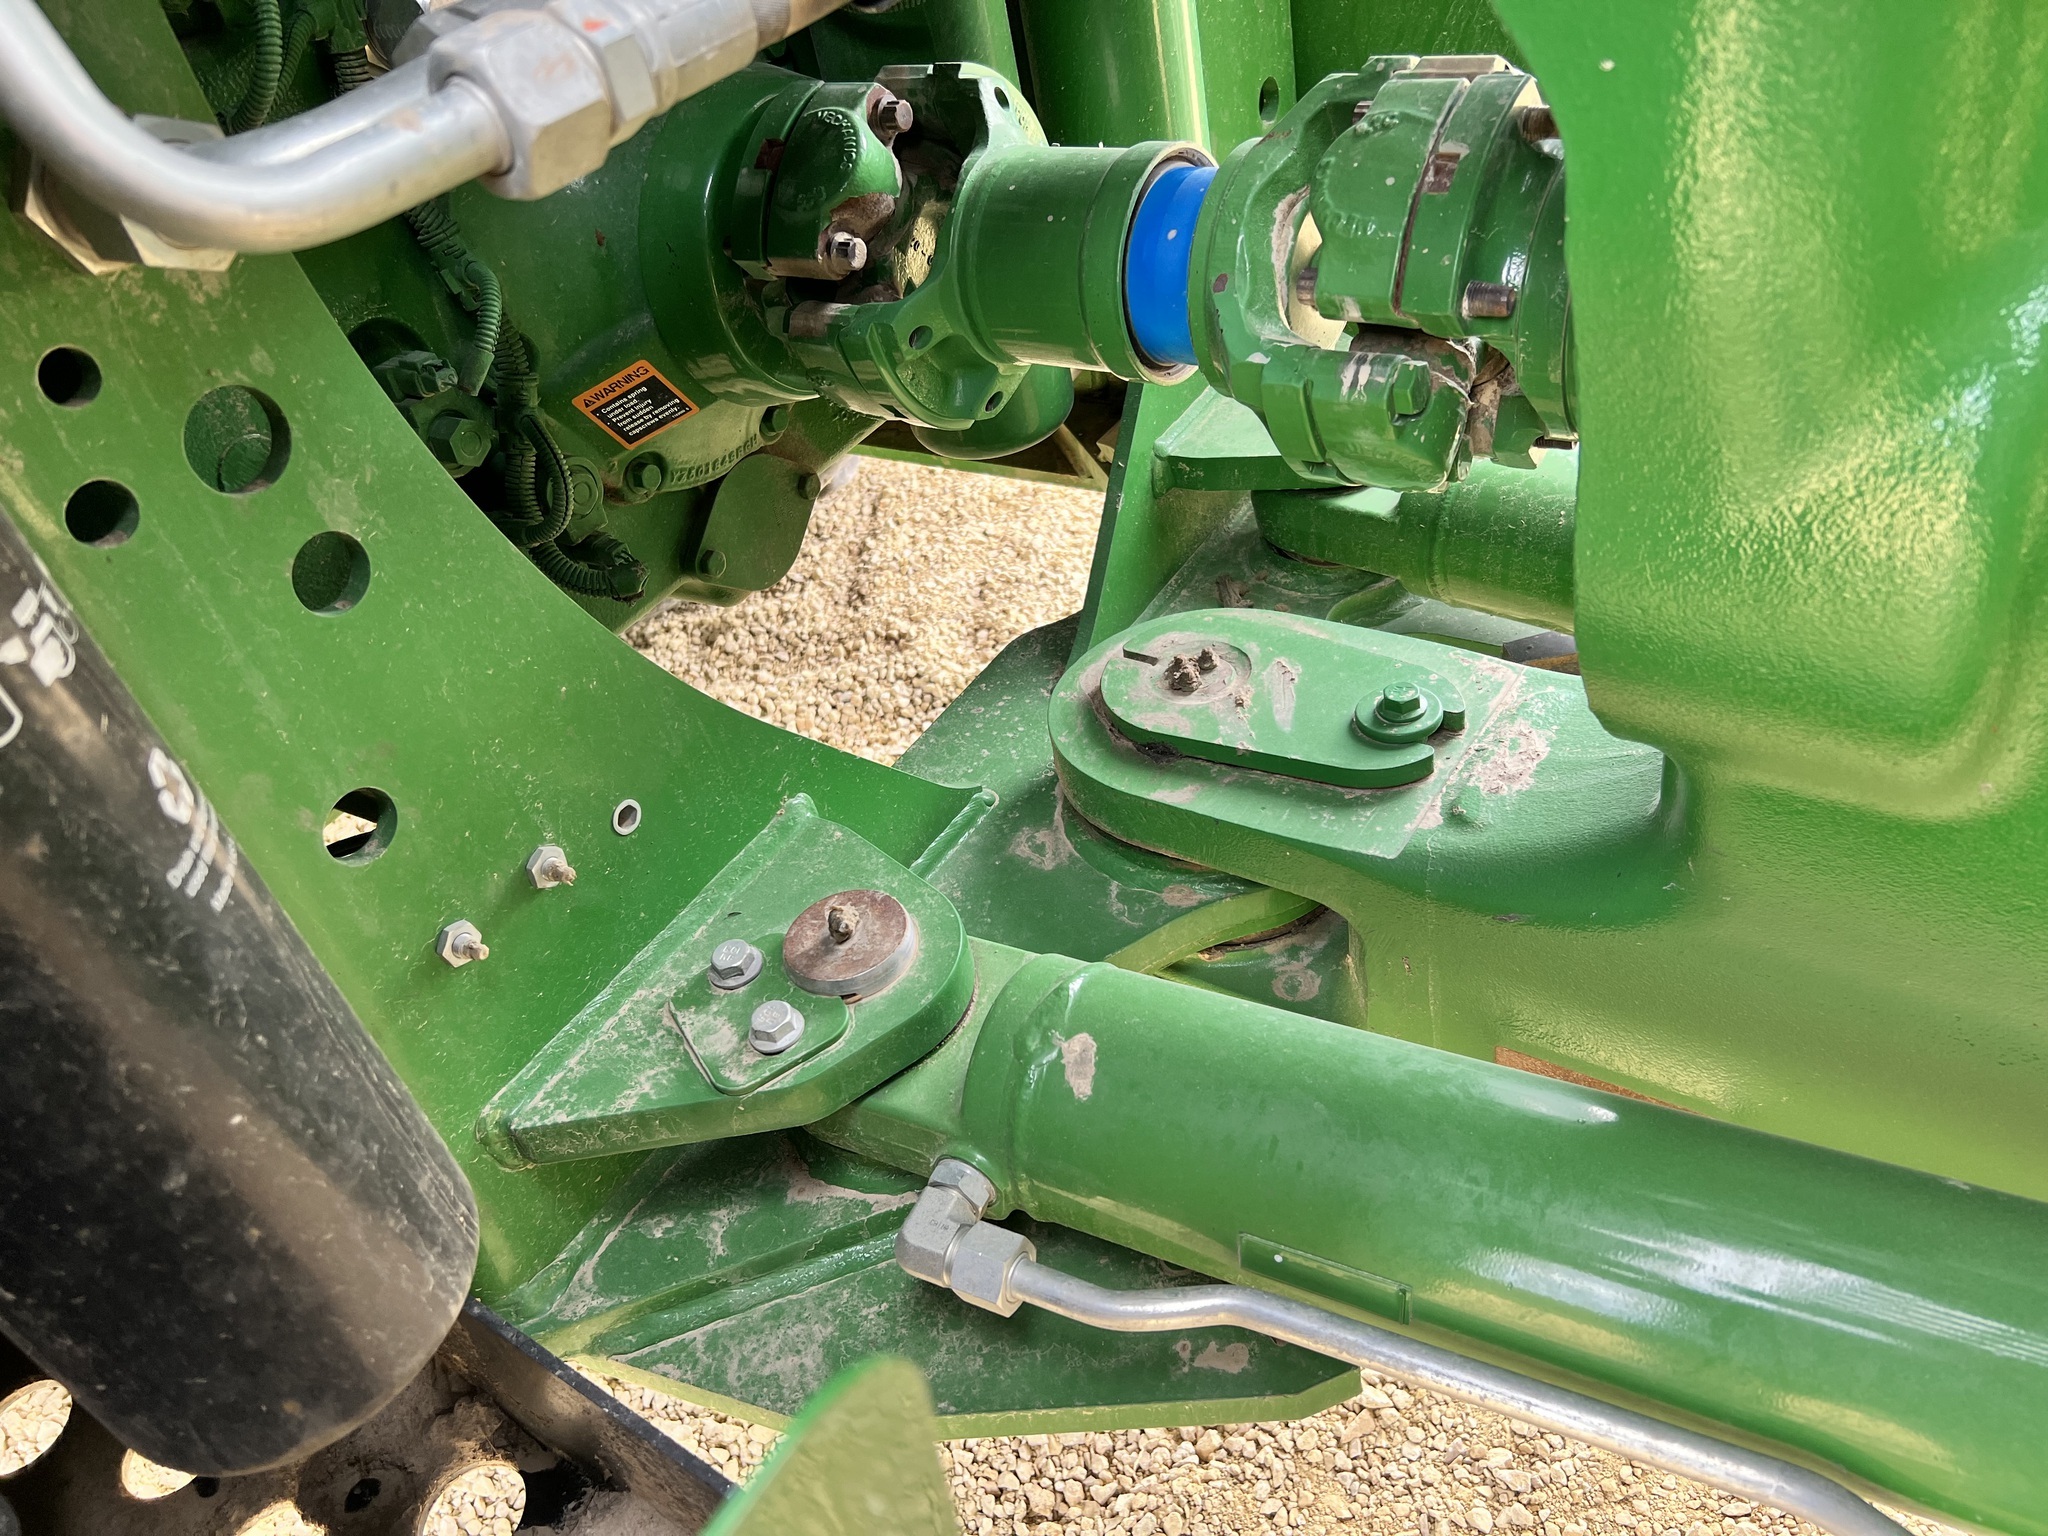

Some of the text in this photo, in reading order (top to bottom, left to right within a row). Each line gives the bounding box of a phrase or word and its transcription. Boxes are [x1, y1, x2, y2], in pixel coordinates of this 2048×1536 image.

[590, 366, 649, 401] WARNING
[601, 386, 647, 413] Contains spring
[608, 398, 640, 419] under load.
[611, 408, 634, 422] Prevent
[617, 405, 653, 427] from sudden
[623, 418, 644, 431] release
[643, 413, 653, 421] by
[653, 398, 680, 415] removing
[629, 418, 658, 436] capscrews
[659, 406, 680, 419] evenly.
